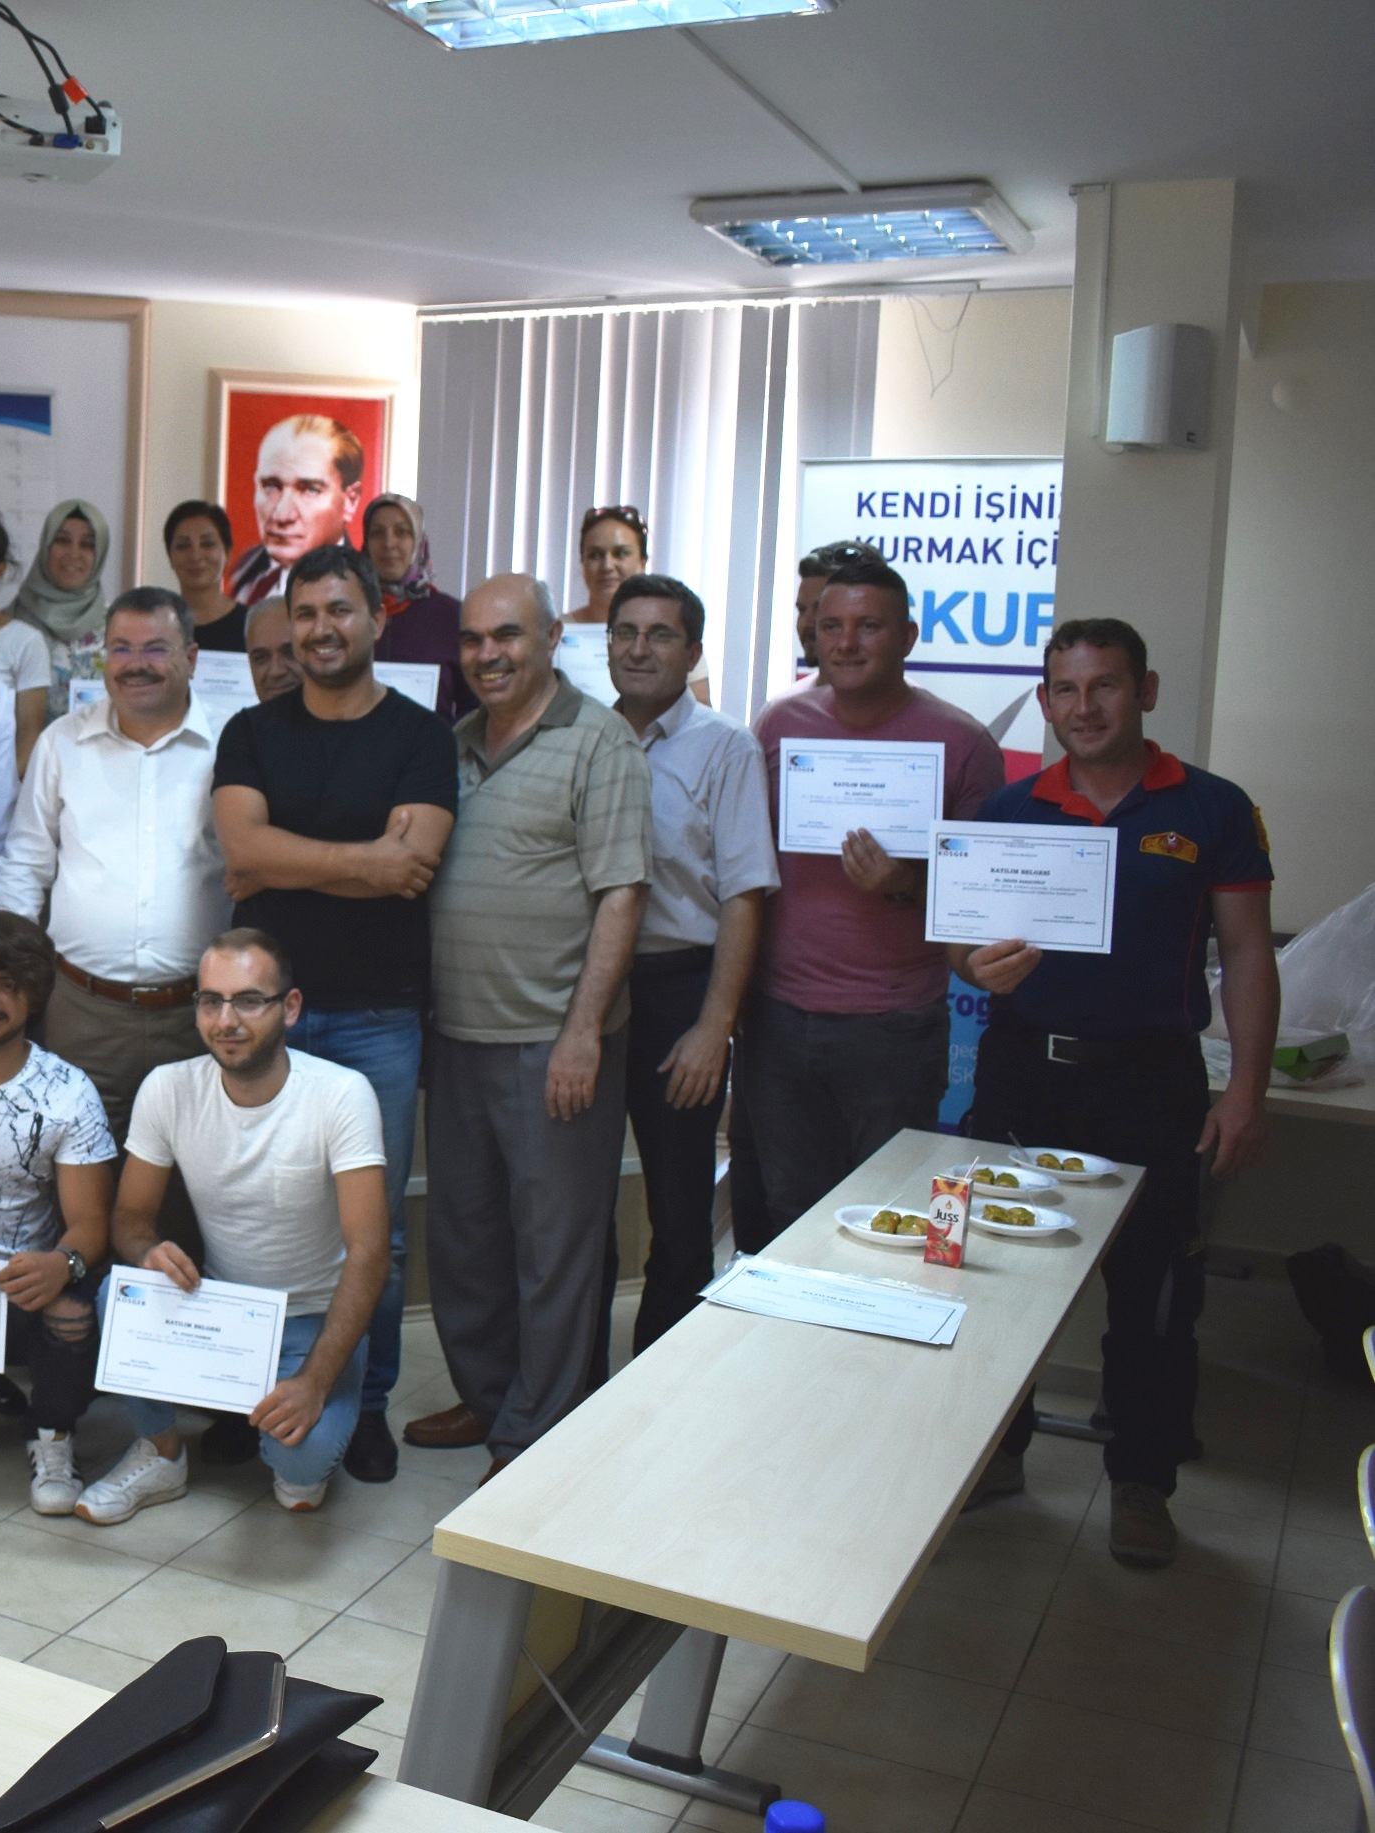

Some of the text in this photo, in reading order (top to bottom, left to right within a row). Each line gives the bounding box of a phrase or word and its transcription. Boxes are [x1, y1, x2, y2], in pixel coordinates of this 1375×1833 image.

[856, 484, 1060, 523] KENDİ İŞİNİ
[1016, 530, 1059, 570] İÇİ
[934, 1208, 960, 1223] Juss
